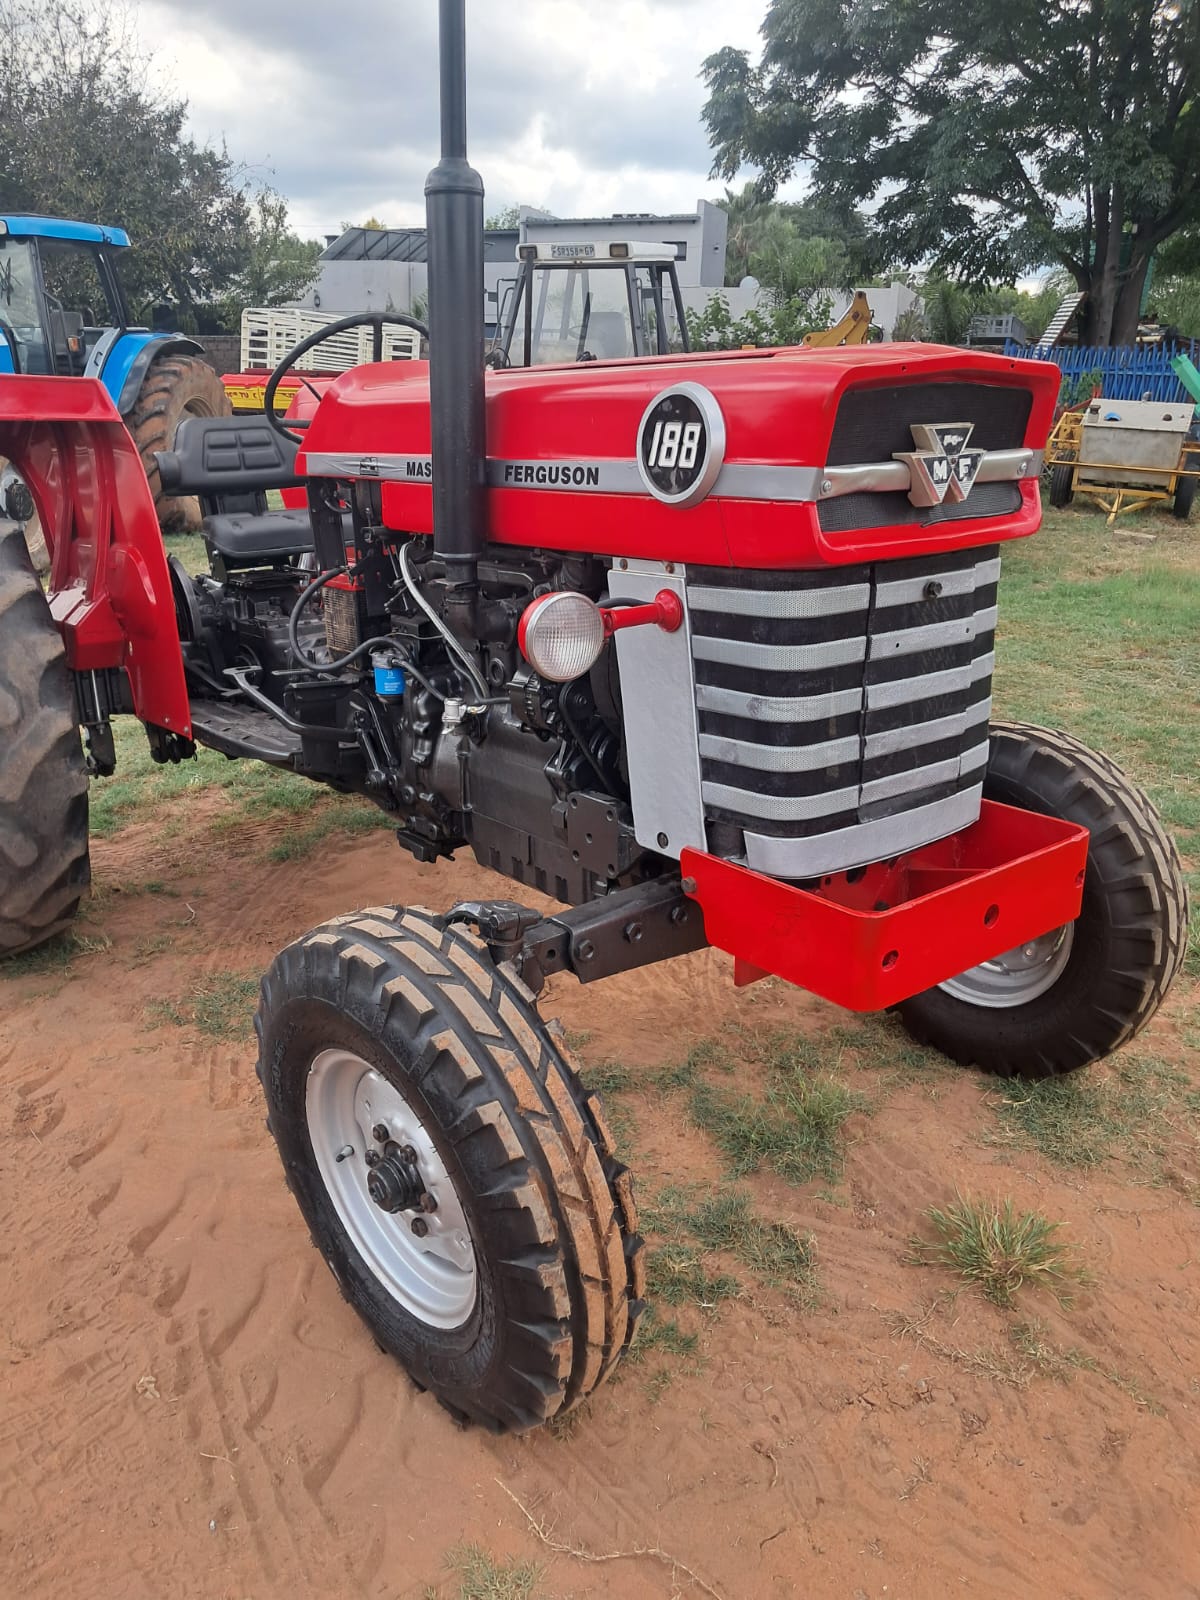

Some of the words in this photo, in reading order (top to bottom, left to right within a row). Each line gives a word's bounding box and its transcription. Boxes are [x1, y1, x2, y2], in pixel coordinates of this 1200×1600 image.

[648, 421, 702, 469] 188
[406, 461, 432, 478] MAS
[504, 465, 599, 486] FERGUSON
